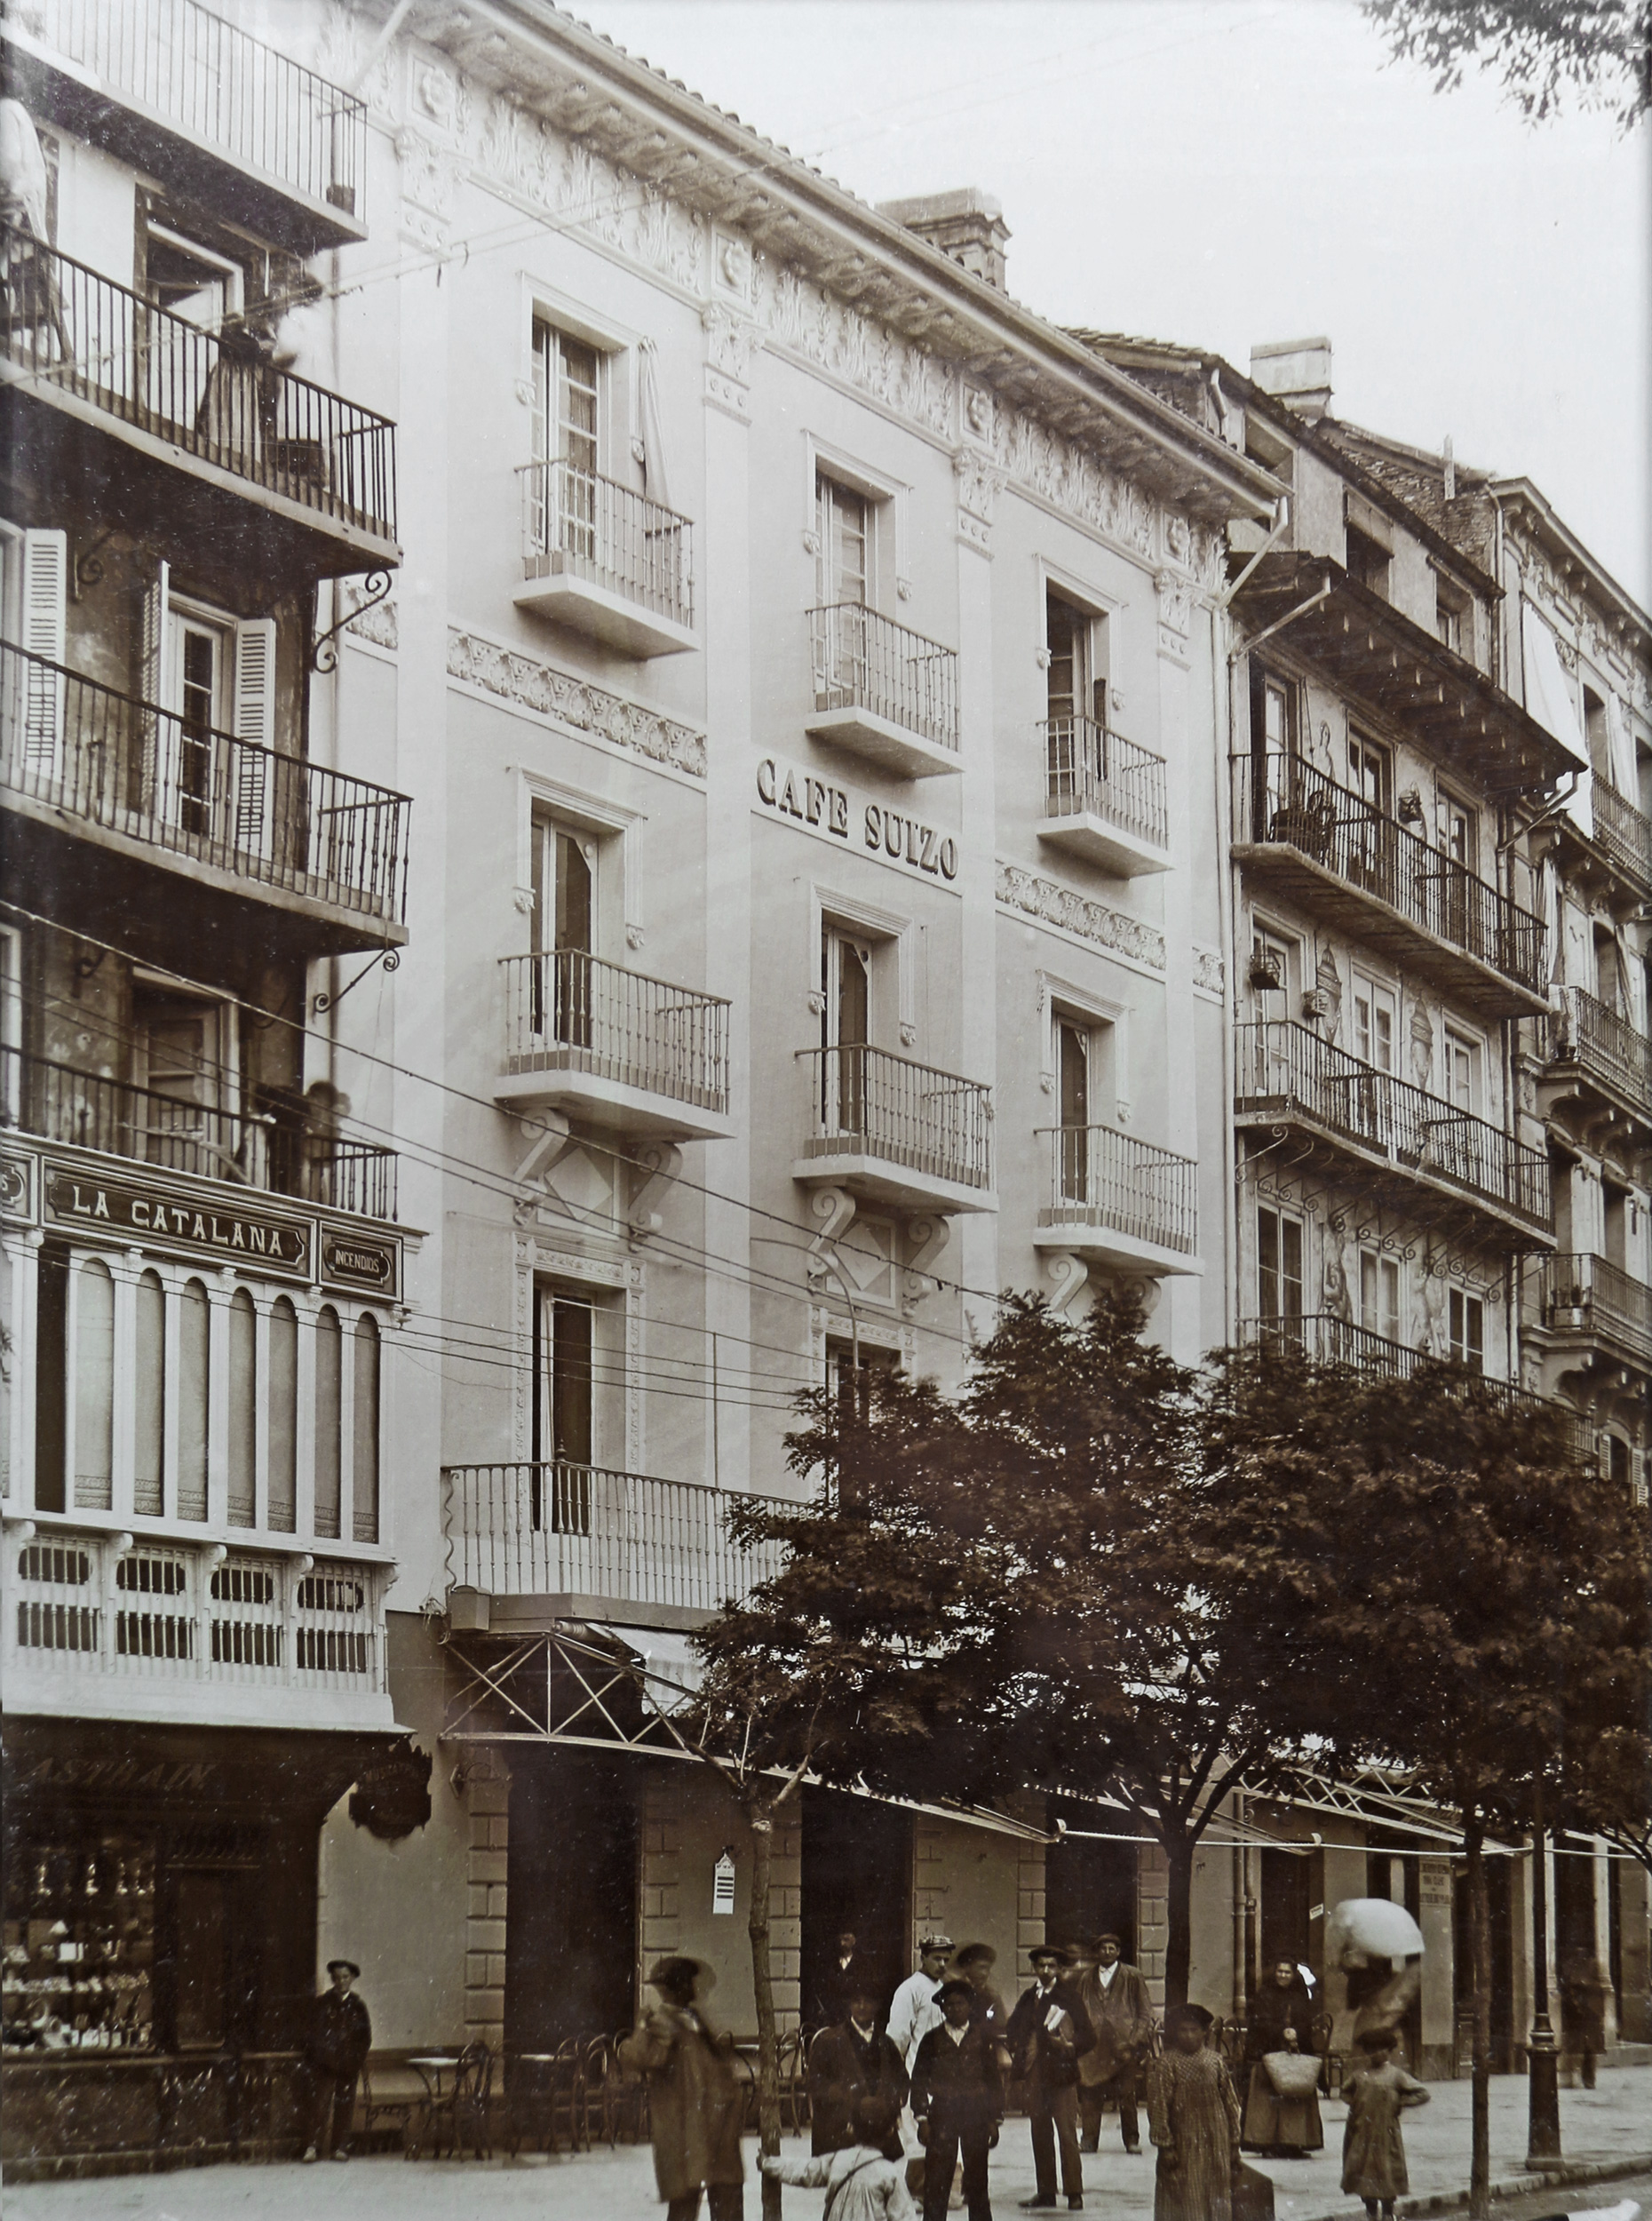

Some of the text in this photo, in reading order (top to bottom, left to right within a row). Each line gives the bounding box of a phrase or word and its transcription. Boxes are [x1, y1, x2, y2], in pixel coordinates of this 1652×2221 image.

[757, 759, 958, 880] CAFE SUIZO
[73, 1185, 283, 1256] LA CATALANA
[335, 1249, 379, 1273] INCENDIOS
